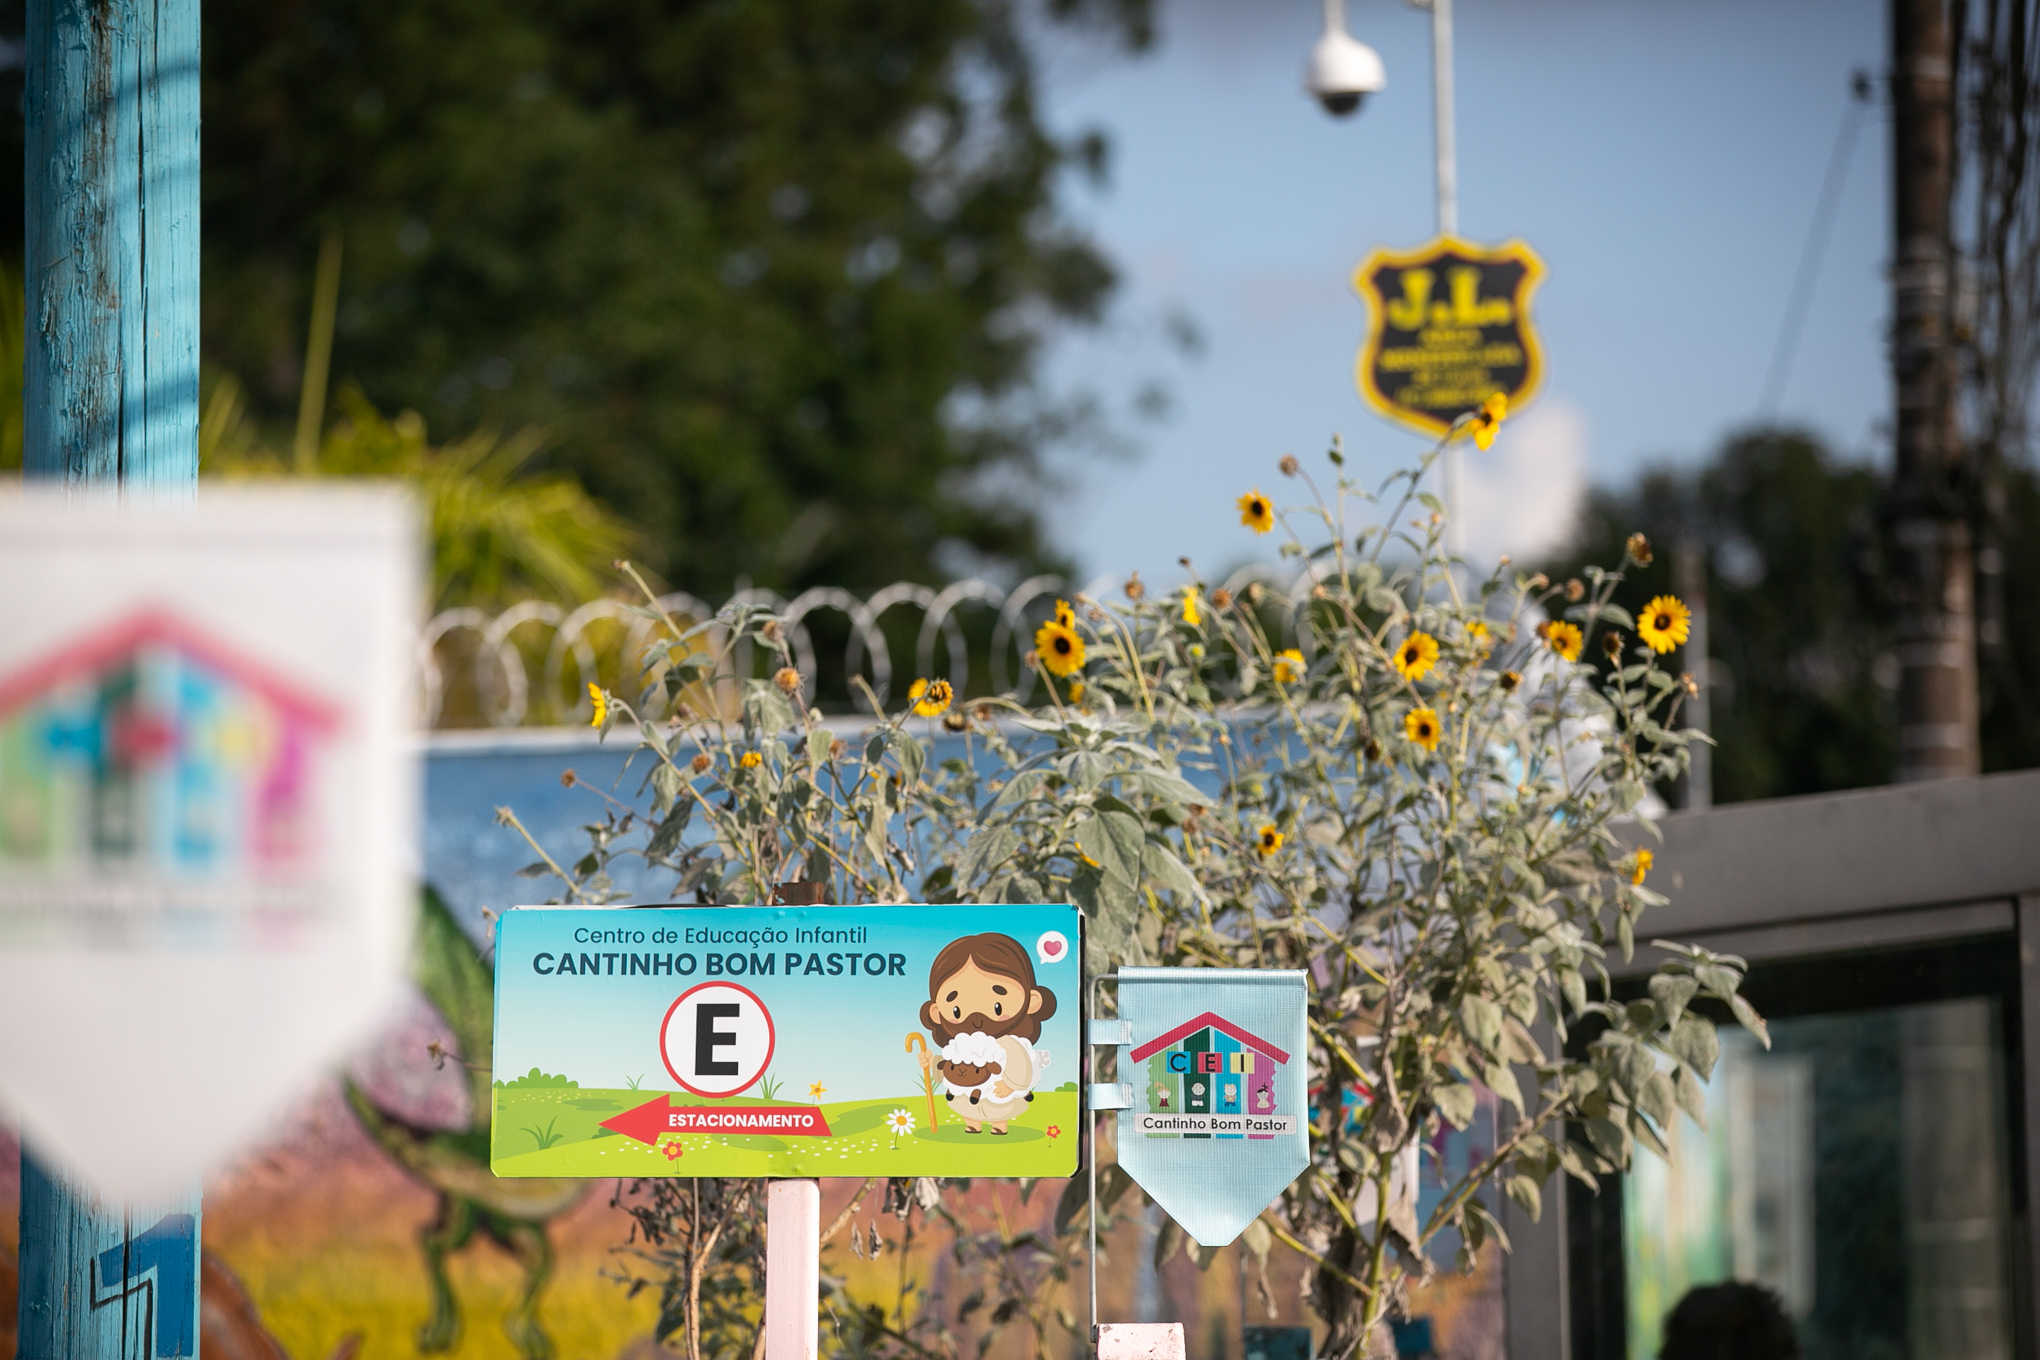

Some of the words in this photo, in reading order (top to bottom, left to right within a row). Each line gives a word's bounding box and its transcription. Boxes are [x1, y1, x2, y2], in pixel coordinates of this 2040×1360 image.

[573, 926, 646, 945] Centro
[651, 926, 679, 945] de
[684, 926, 789, 949] Educação
[794, 925, 868, 945] Infantil
[532, 952, 698, 976] CANTINHO
[705, 952, 776, 976] BOM
[784, 952, 907, 976] PASTOR
[694, 1003, 741, 1076] E
[668, 1113, 815, 1128] ESTACIONAMENTO
[1143, 1116, 1206, 1130] Cantinho
[1211, 1118, 1242, 1130] Bom
[1245, 1118, 1288, 1131] Pastor
